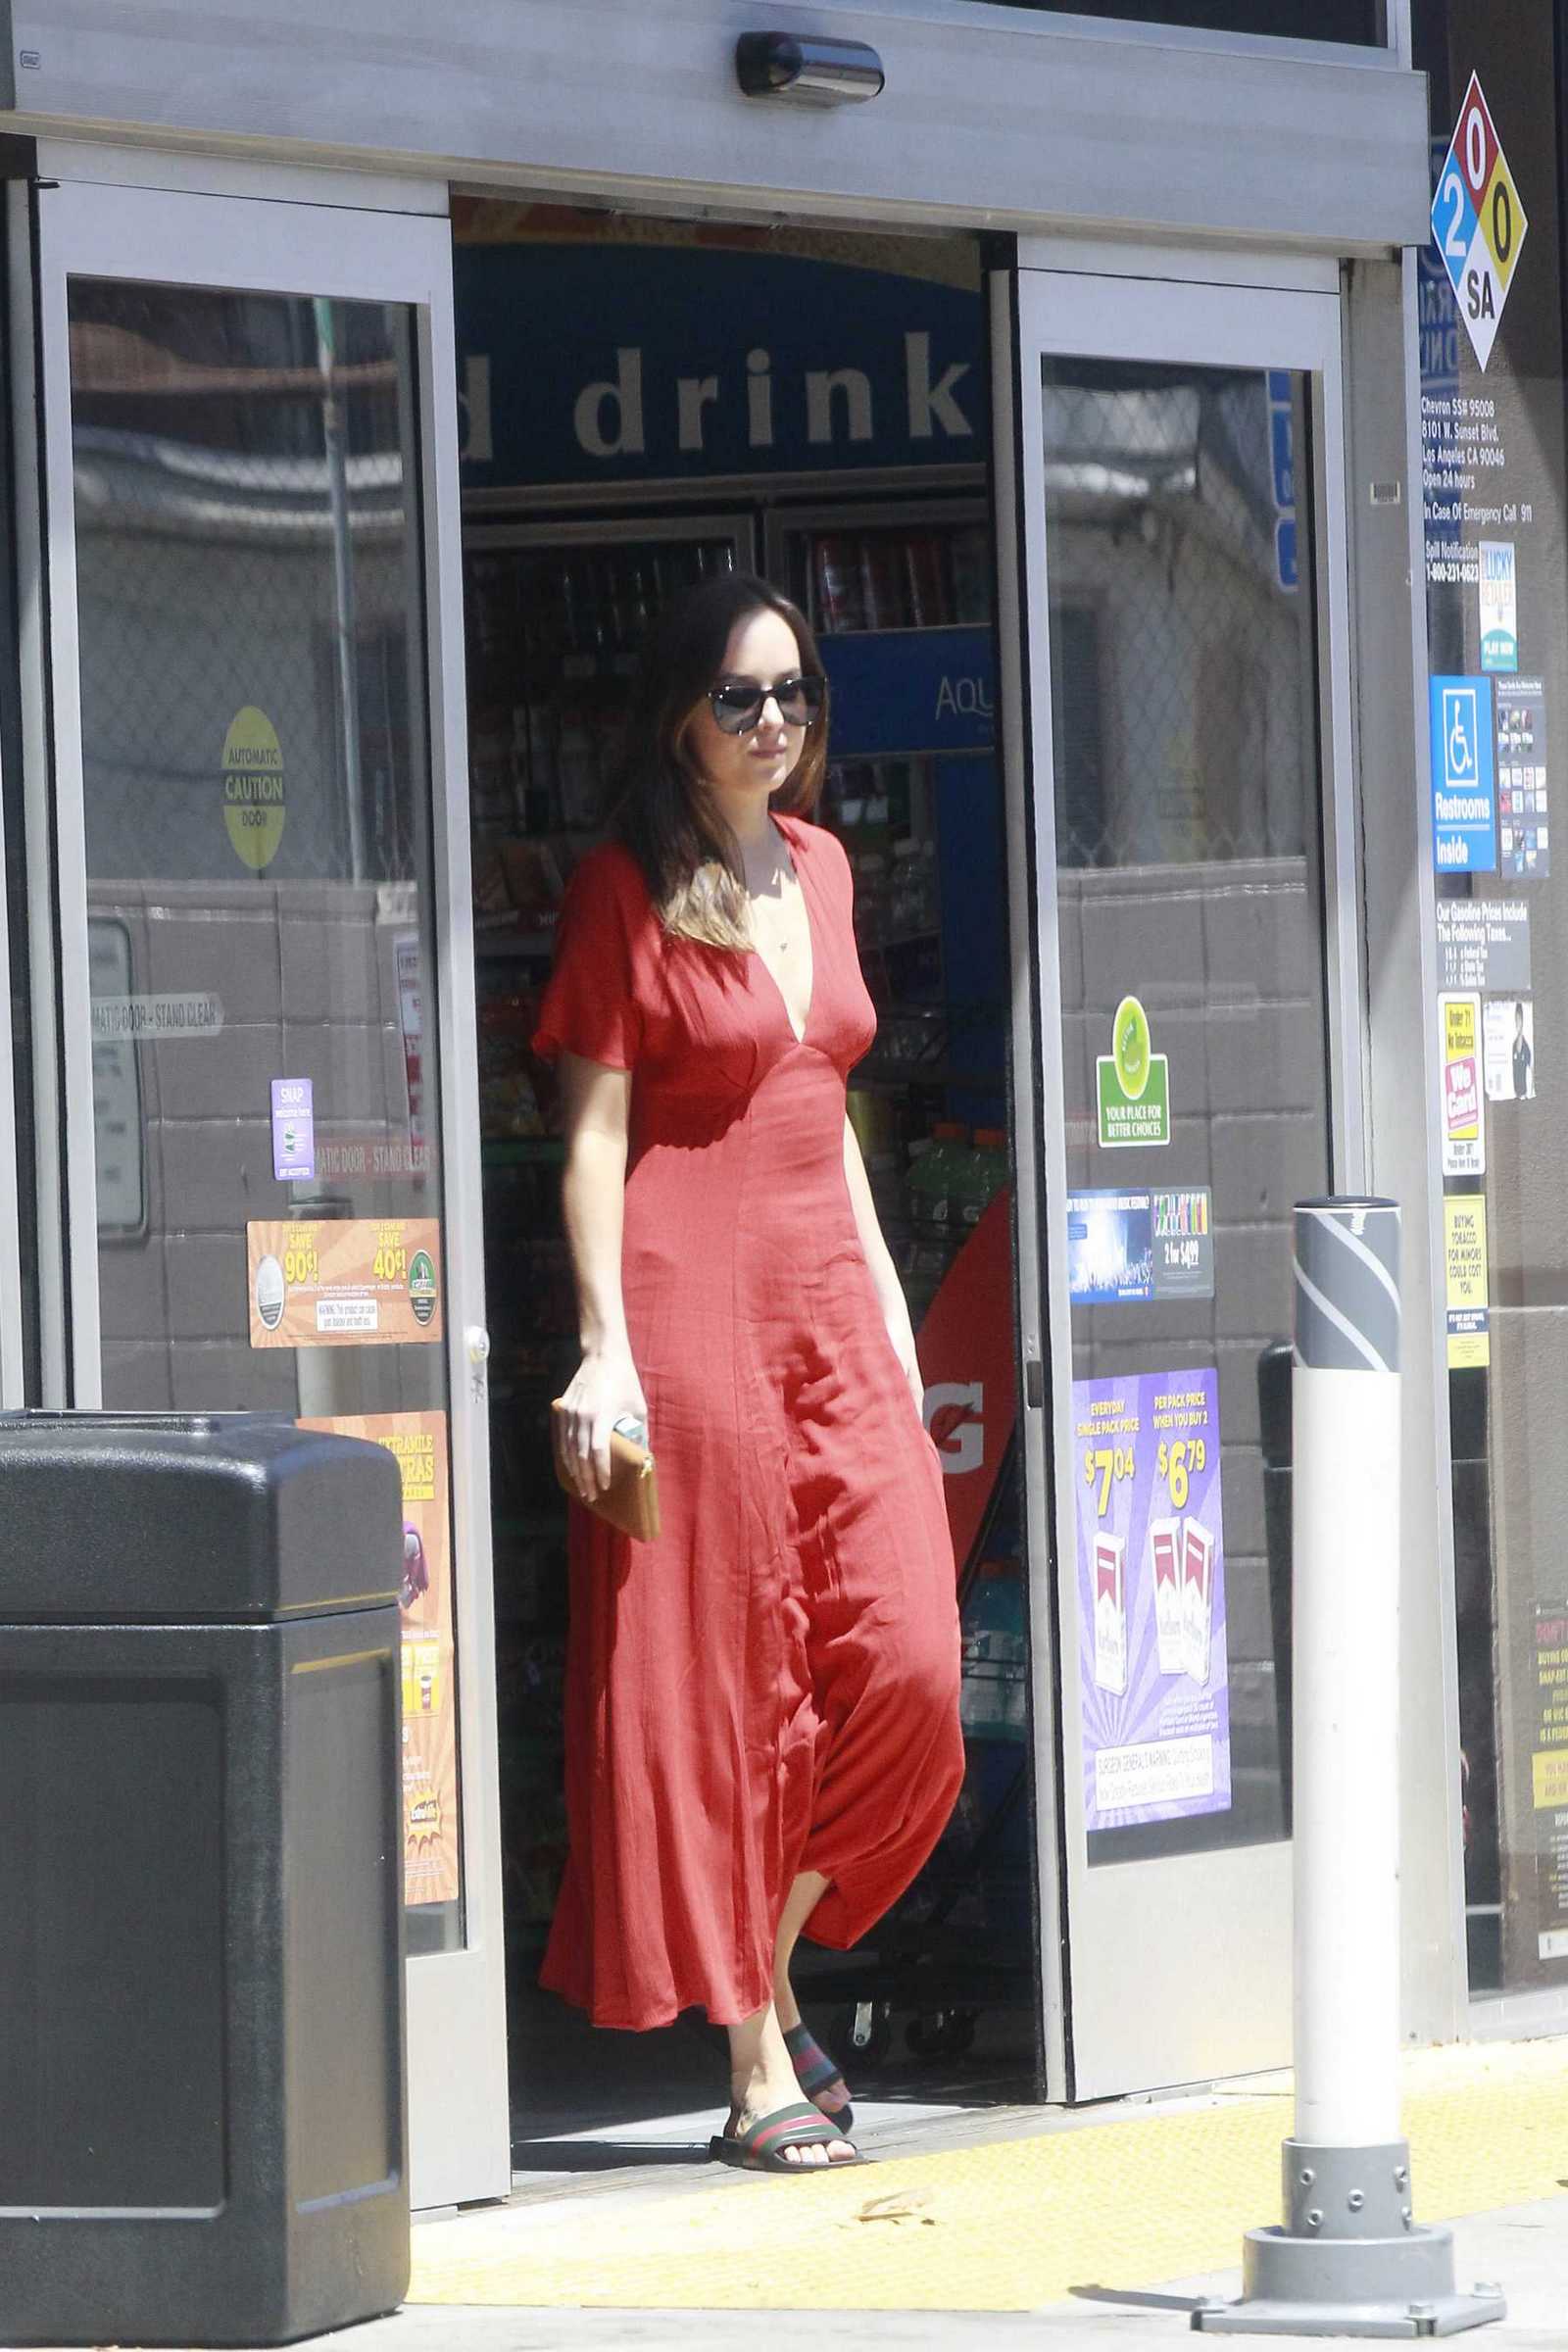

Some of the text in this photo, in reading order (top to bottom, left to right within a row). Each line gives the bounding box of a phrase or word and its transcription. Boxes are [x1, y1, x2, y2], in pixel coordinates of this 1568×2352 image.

[1466, 107, 1486, 190] 0
[1444, 172, 1512, 264] 2 0
[1467, 270, 1495, 319] SA
[574, 331, 973, 458] drink
[1421, 396, 1450, 415] Chevron
[1422, 419, 1499, 442] 8101 W. Sunset Blvd.
[1423, 445, 1505, 467] Los Angeles CA 90046
[1423, 469, 1475, 489] Open 24 hours
[1424, 502, 1533, 524] In Case Of Emergency Call 911
[1426, 541, 1478, 562] Spill Notification
[227, 749, 278, 764] AUTOMATIC
[225, 775, 283, 800] CAUTION
[1435, 792, 1491, 820] Restrooms
[242, 809, 268, 827] DOOR
[1436, 836, 1468, 864] Inside
[1437, 902, 1450, 921] Our
[1450, 902, 1481, 921] Gasoline
[1482, 902, 1501, 921] Prices
[1438, 922, 1450, 941] The
[1451, 922, 1486, 946] Following
[122, 1004, 146, 1028] DOOR
[156, 1004, 184, 1027] STAND
[187, 1003, 216, 1026] CLEAR
[1105, 1104, 1161, 1121] YOUR PLACE FOR
[1107, 1123, 1131, 1138] BETTER
[1132, 1121, 1160, 1137] CHOICES
[373, 1146, 402, 1172] STAND
[1164, 1242, 1169, 1264] 2
[1091, 1400, 1125, 1417] EVERYDAY
[1153, 1392, 1206, 1411] PER PACK PRICE
[923, 1382, 983, 1473] G
[1077, 1417, 1140, 1438] SINGLE PACK PRICE
[1152, 1410, 1208, 1430] WHEN YOU BUY 2
